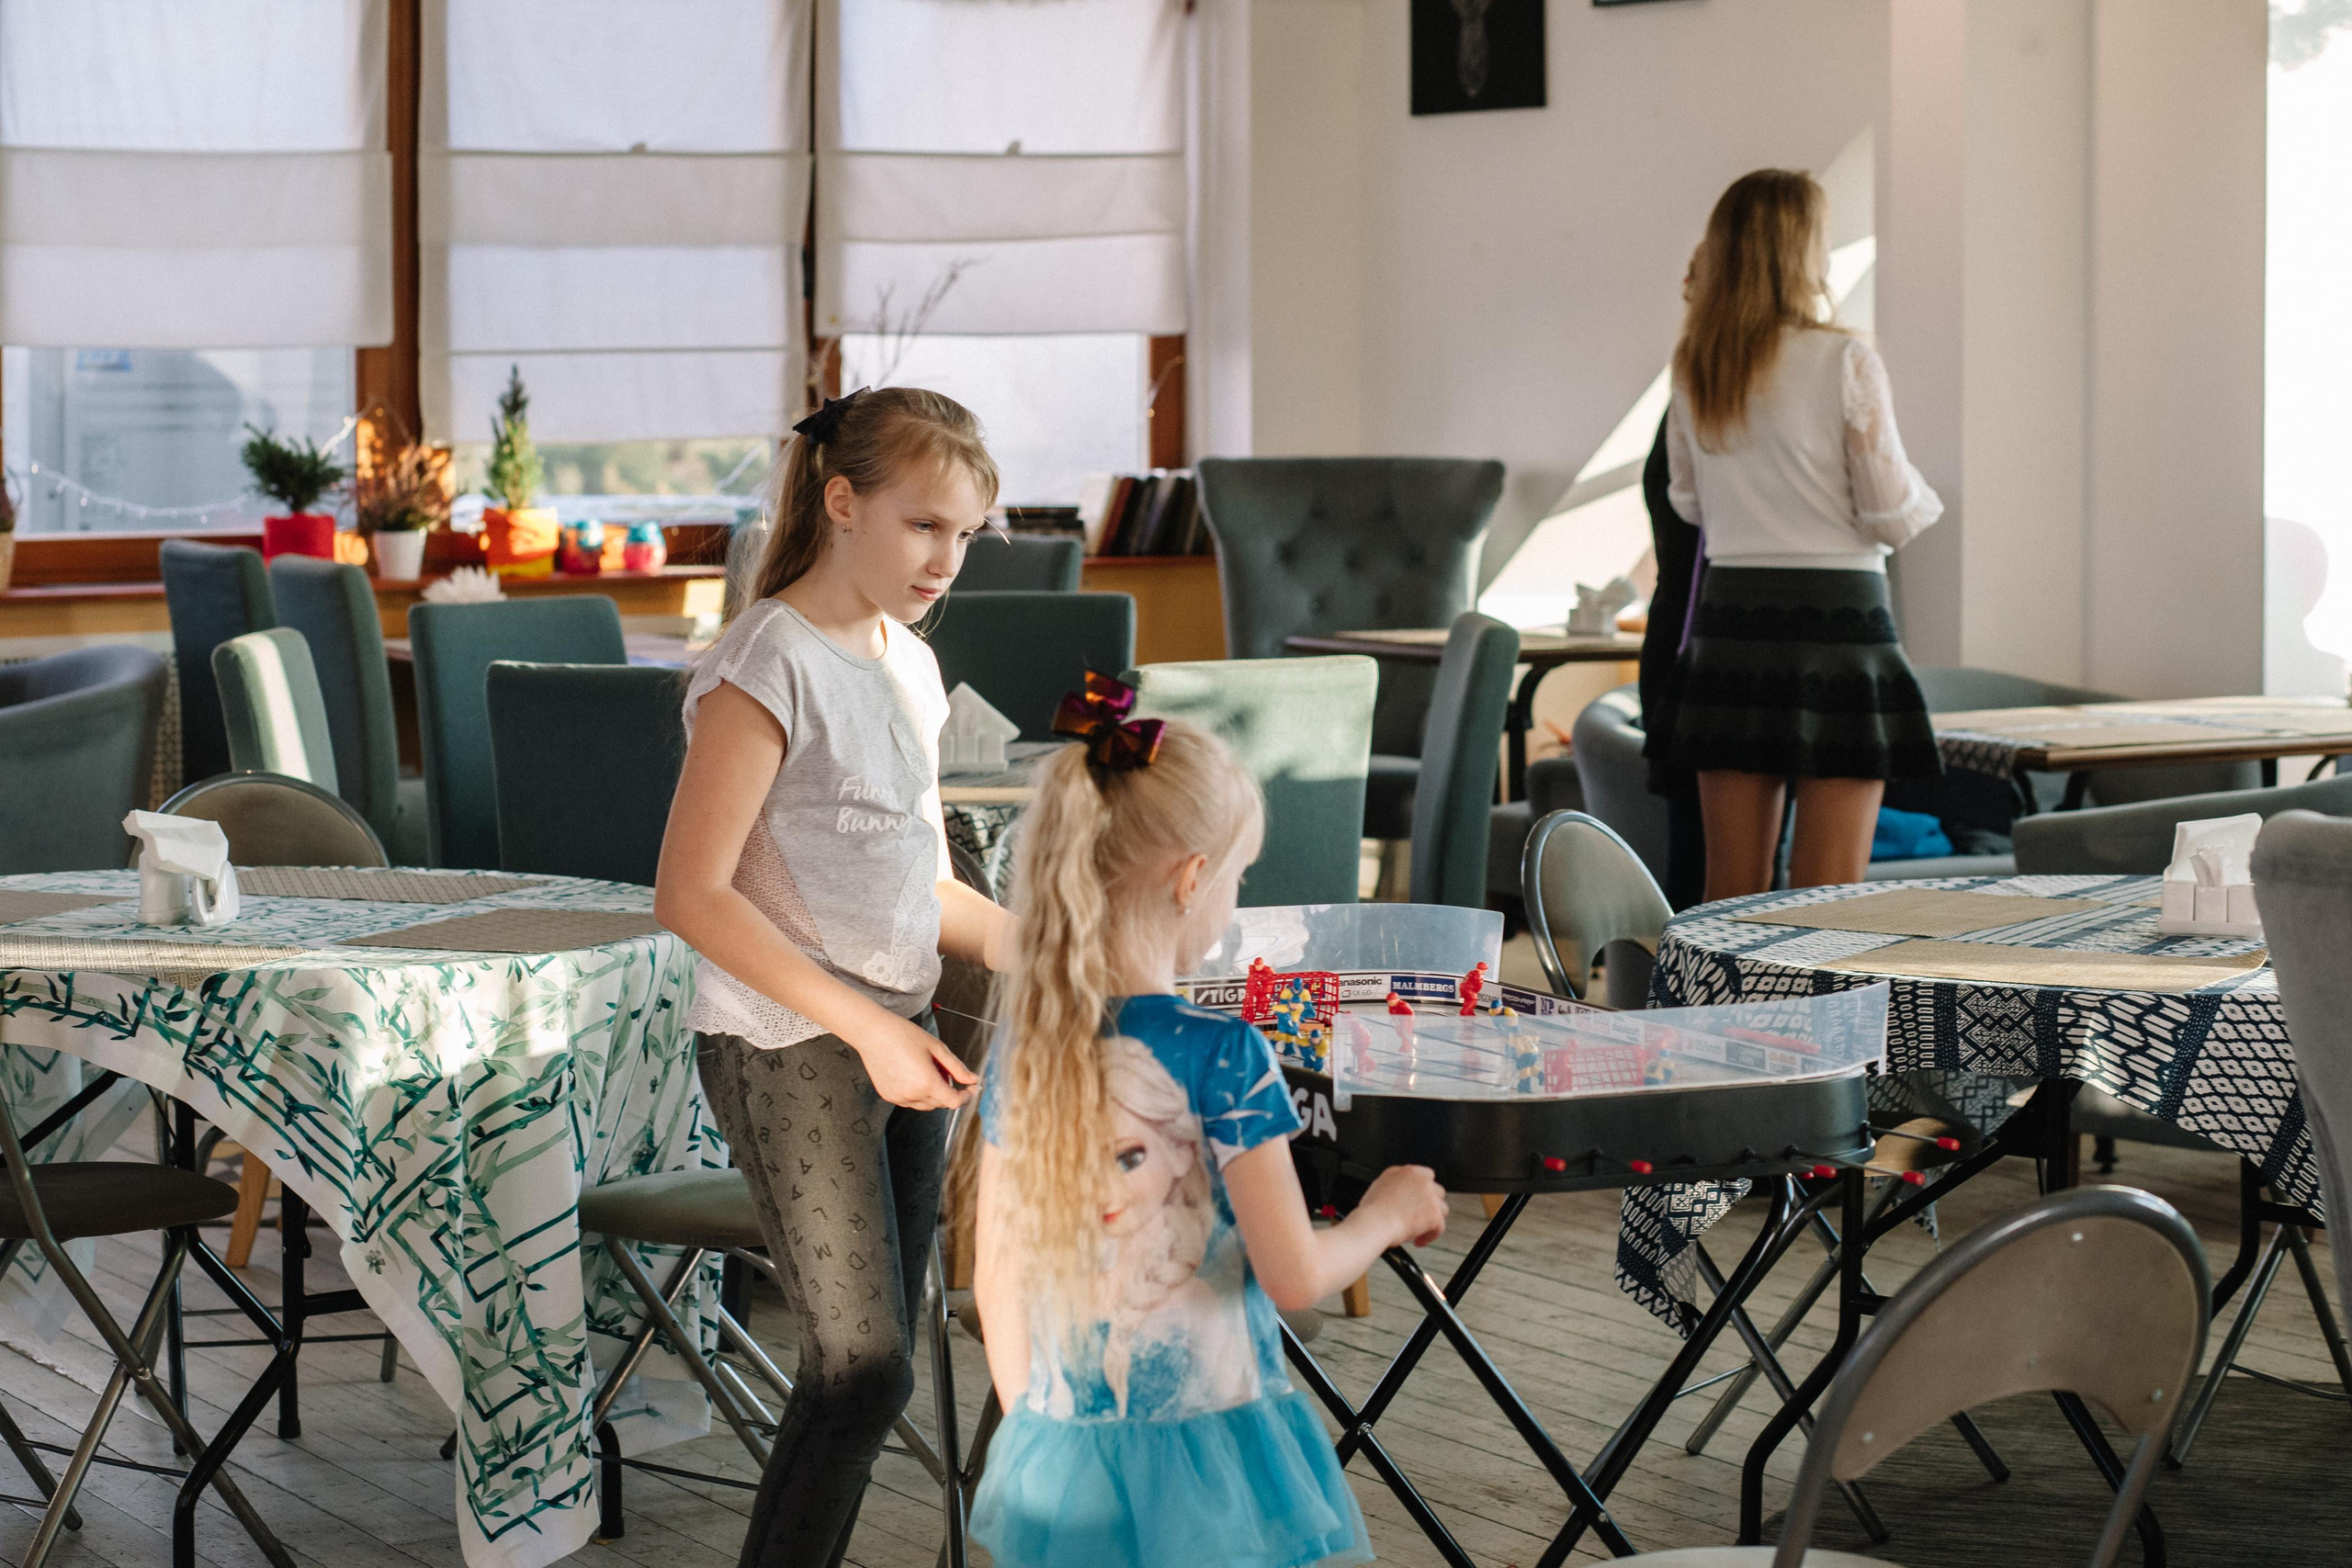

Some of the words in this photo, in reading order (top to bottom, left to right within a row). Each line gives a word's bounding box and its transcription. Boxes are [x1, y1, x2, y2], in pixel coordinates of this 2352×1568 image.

[836, 807, 912, 840] Bunny
[1336, 976, 1383, 987] anasonic
[1392, 981, 1454, 993] MALMBERGS
[1289, 1086, 1337, 1142] GA
